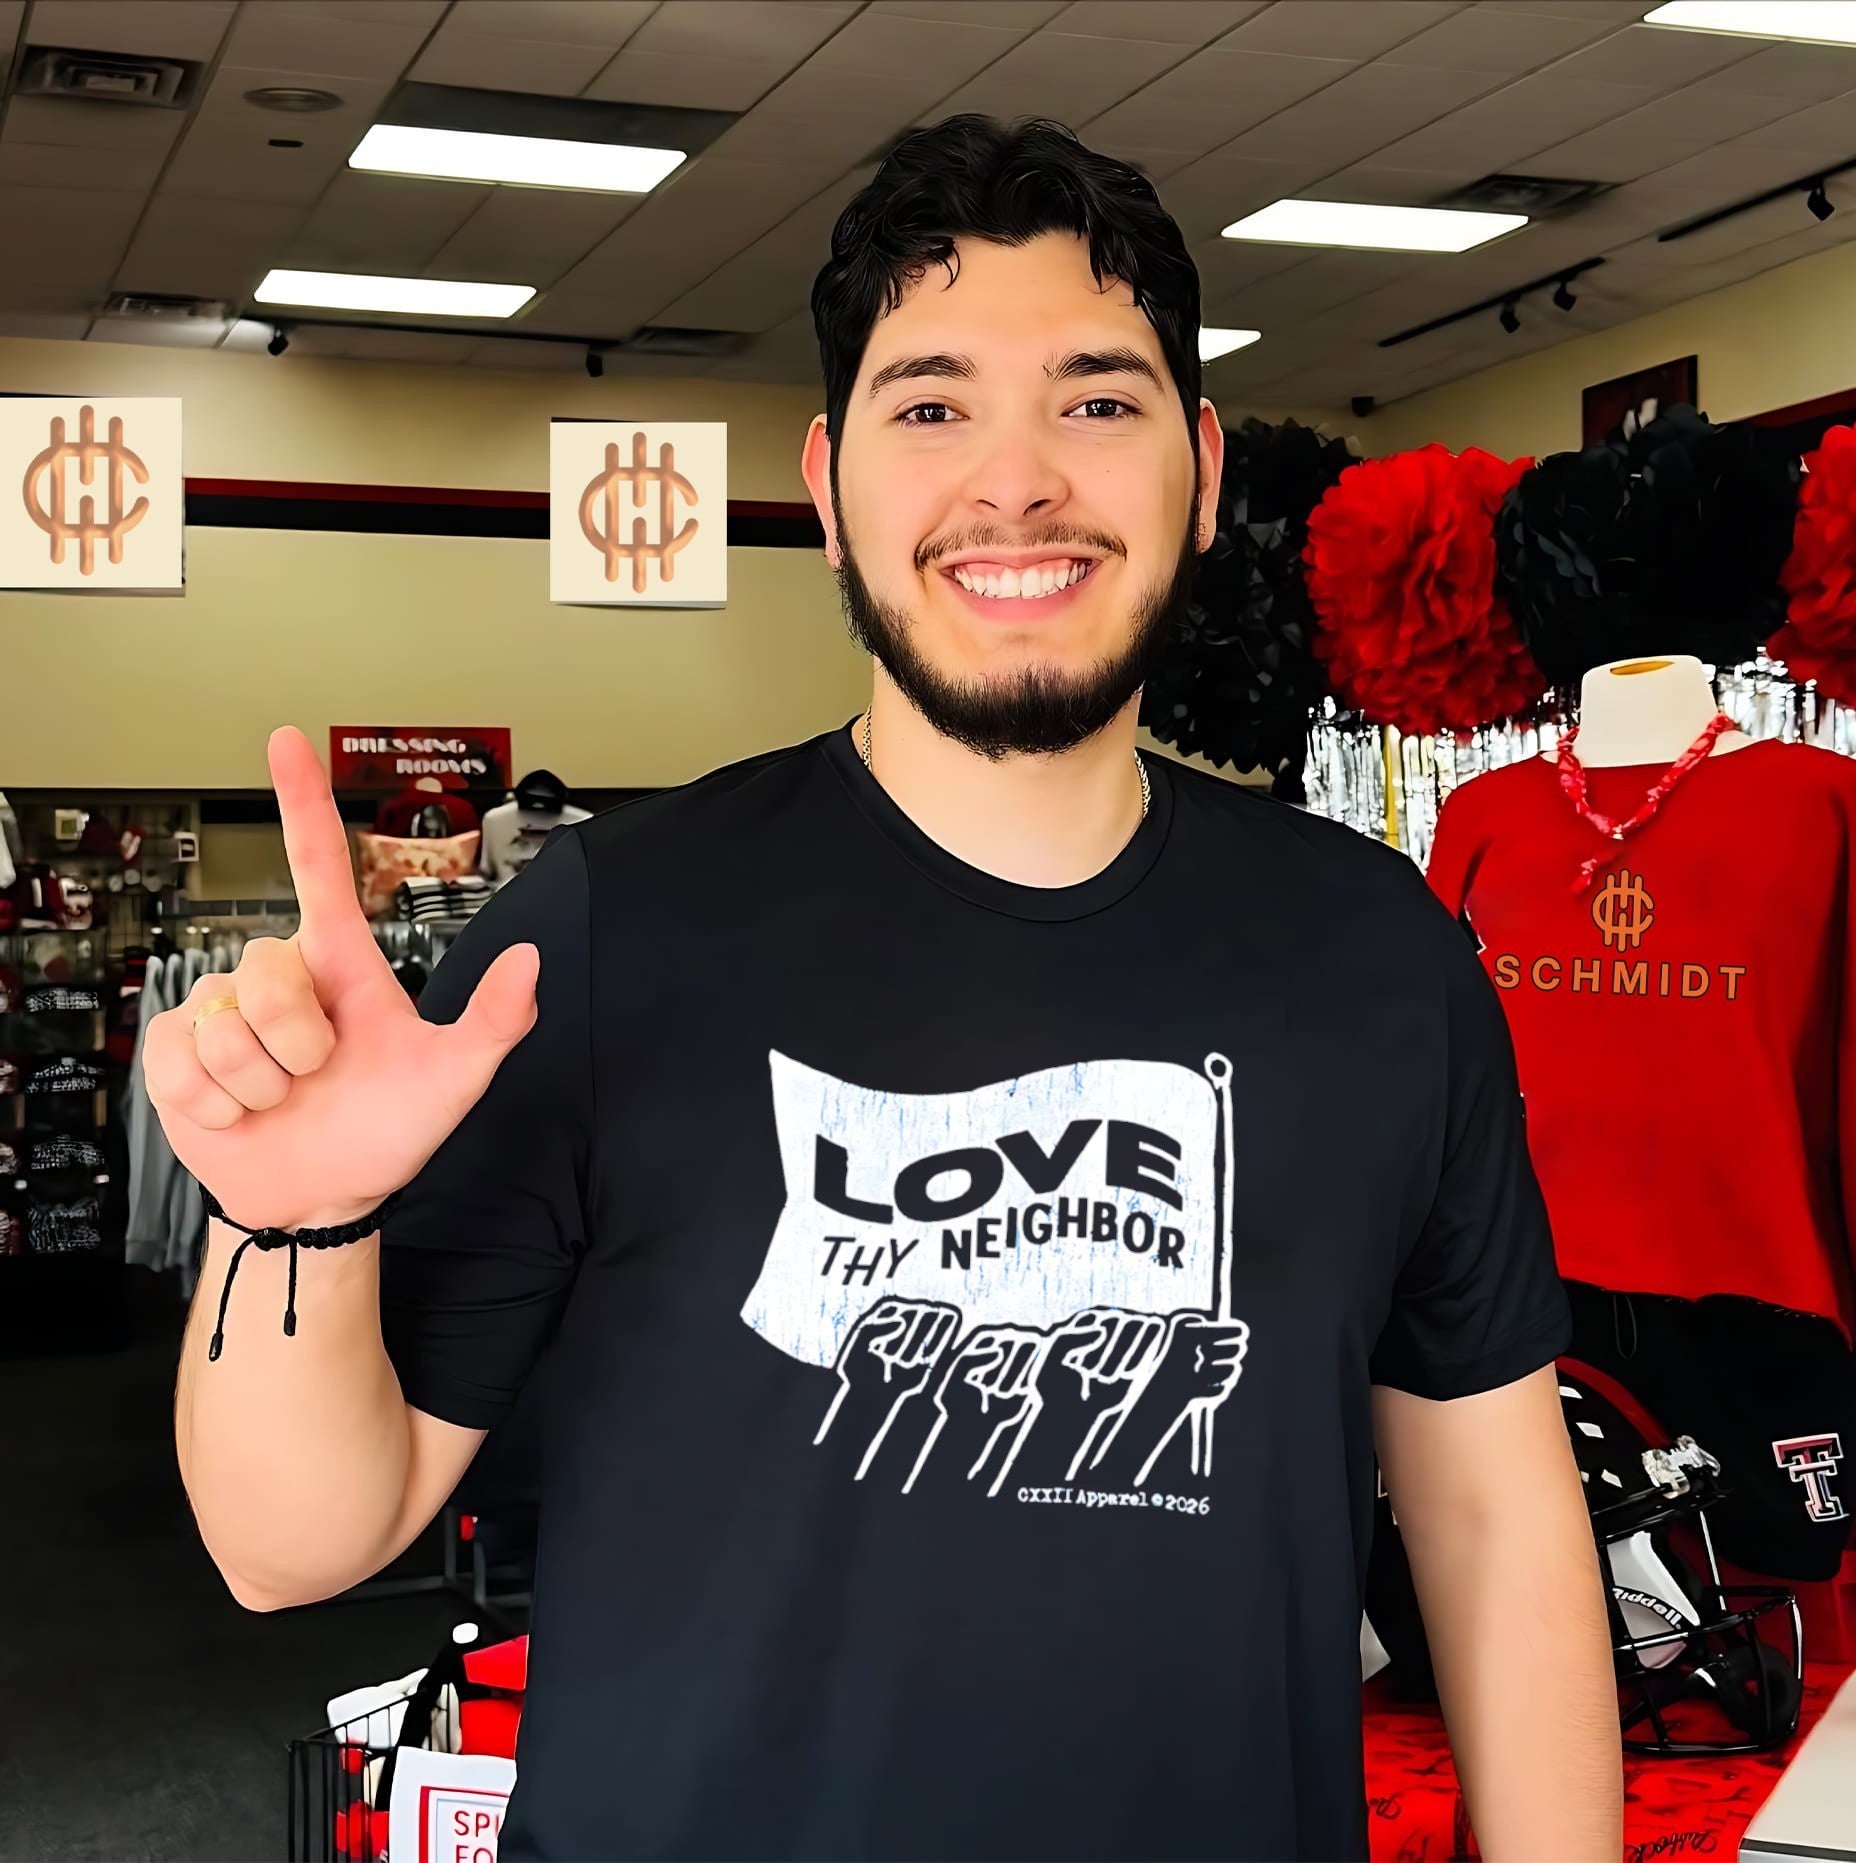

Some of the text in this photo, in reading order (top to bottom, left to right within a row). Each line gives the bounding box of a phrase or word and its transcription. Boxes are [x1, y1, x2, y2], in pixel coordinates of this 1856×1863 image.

[342, 737, 466, 753] DRESSING
[396, 758, 486, 775] ROOMS
[1494, 953, 1747, 1000] SCHMIDT
[814, 1119, 1183, 1225] LOVE
[821, 1196, 1185, 1286] THY NEIGHBOR
[1017, 1487, 1074, 1504] CXXII
[1075, 1489, 1149, 1508] Apparel
[454, 1810, 500, 1838] SPI
